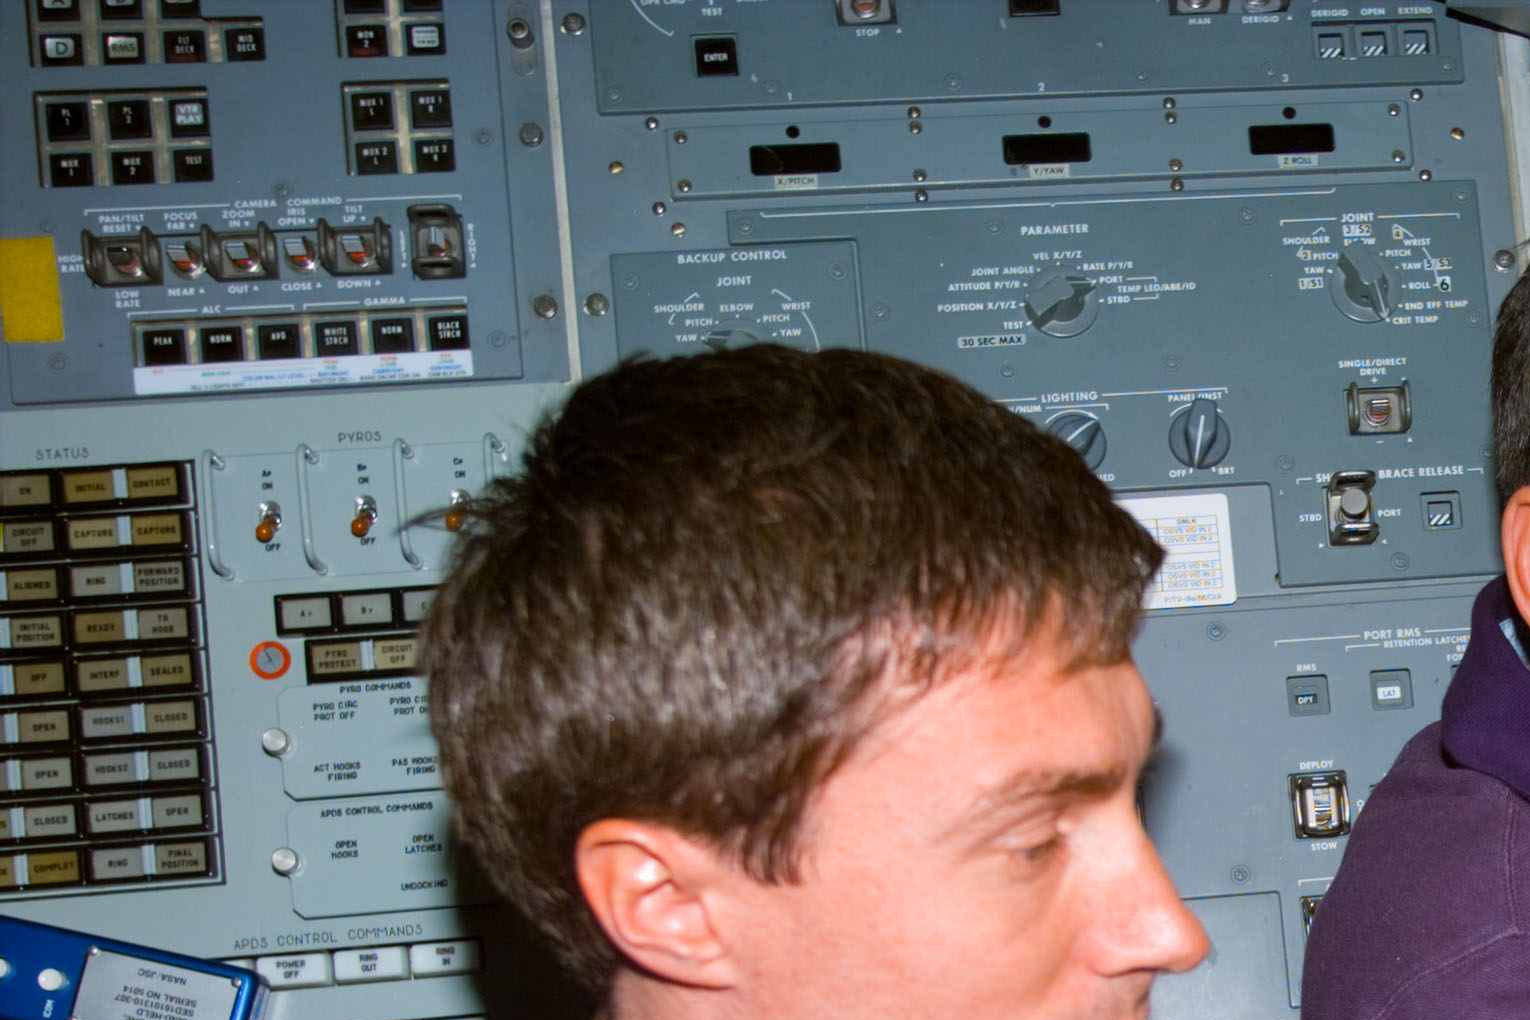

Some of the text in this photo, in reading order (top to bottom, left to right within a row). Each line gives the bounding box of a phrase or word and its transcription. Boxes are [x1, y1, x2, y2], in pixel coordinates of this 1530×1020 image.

[702, 8, 722, 16] TEST
[1311, 9, 1349, 17] DERIGID
[1361, 8, 1385, 16] OPEN
[1398, 6, 1433, 15] EXTEND
[856, 28, 879, 37] STOP
[55, 42, 68, 55] D
[704, 53, 728, 62] ENTER
[1282, 73, 1289, 83] 3
[1038, 82, 1045, 92] 2
[1033, 167, 1064, 176] Y/YAW
[776, 176, 815, 188] X/PITCH
[234, 197, 342, 209] CAMERA COMMAND
[287, 208, 306, 216] IRIS
[345, 205, 363, 214] TILT
[99, 213, 144, 223] PAN/TILT
[164, 211, 198, 221] FOCUS
[222, 210, 255, 219] ZOOM
[343, 214, 357, 223] UP
[1341, 213, 1375, 223] JOINT
[228, 219, 241, 228] IN
[278, 217, 306, 226] OPEN
[103, 223, 132, 232] RESET
[166, 222, 185, 231] FAR
[1020, 224, 1089, 236] PARAMETER
[1283, 236, 1330, 245] SHOULDER
[1403, 237, 1431, 246] WRIST
[677, 250, 787, 264] BACKUP CONTROL
[1033, 250, 1083, 261] VEL X/Y/Z
[1313, 252, 1339, 260] PITCH
[1385, 249, 1411, 257] PITCH
[1083, 263, 1104, 271] RATE
[1304, 266, 1324, 274] YAW
[1402, 262, 1422, 270] YAW
[971, 266, 1035, 277] JOINT ANGLE
[337, 279, 371, 289] DOWN
[716, 275, 752, 287] JOINT
[1099, 275, 1123, 284] PORT
[281, 282, 312, 291] CLOSE
[948, 282, 991, 292] ATTITUDE
[1409, 282, 1431, 290] ROLL
[1440, 278, 1449, 291] 6
[168, 288, 195, 297] NEAR
[228, 285, 248, 294] OUT
[1118, 285, 1141, 294] TEMP
[115, 290, 139, 300] LOW
[115, 299, 141, 309] RATE
[364, 297, 406, 306] GAMMA
[1107, 296, 1130, 304] STBD
[202, 305, 221, 314] ALC
[654, 303, 704, 313] SHOULDER
[720, 303, 754, 312] ELBOW
[781, 302, 811, 311] WRIST
[938, 300, 1017, 312] POSITION X/Y/Z
[1405, 300, 1468, 310] END EFF TEMP
[685, 318, 713, 327] PITCH
[763, 314, 791, 323] PITCH
[1415, 316, 1439, 324] TEMP
[1003, 321, 1024, 330] TEST
[779, 328, 802, 337] YAW
[675, 334, 697, 343] YAW
[961, 336, 1023, 347] 30 SEC MAX
[1338, 357, 1407, 369] SINGLE/DIRECT
[1360, 368, 1387, 376] DRIVE
[1041, 392, 1098, 403] LIGHTING
[337, 431, 382, 443] PYROS
[35, 447, 89, 460] STATUS
[1169, 470, 1187, 478] OFF
[1378, 466, 1464, 479] BRACE RELEASE
[1378, 509, 1401, 517] PORT
[1300, 514, 1322, 522] STBD
[12, 527, 44, 537] CIRCUIT
[74, 529, 113, 538] CAPTURE
[137, 525, 176, 535] CAPTURE
[86, 577, 106, 586] RING
[139, 577, 179, 587] POSITION
[1364, 628, 1421, 639] PORT RMS
[1384, 638, 1432, 648] RETENTION
[1296, 663, 1317, 672] RMS
[340, 681, 411, 694] PYRO COMMANDS
[1382, 689, 1396, 697] LAT
[313, 703, 335, 711] PYRO
[154, 712, 188, 723] CLOSED
[32, 723, 56, 732] OPEN
[157, 760, 191, 770] CLOSED
[314, 761, 361, 773] ACT HOOKS
[1300, 760, 1334, 770] DEPLOY
[35, 770, 59, 779] OPEN
[165, 807, 189, 816] OPEN
[346, 802, 433, 816] CONTROL COMMANDS
[33, 815, 68, 826] CLOSED
[95, 811, 134, 822] LATCHES
[413, 834, 434, 843] OPEN
[335, 840, 357, 849] OPEN
[1311, 842, 1337, 851] STOW
[108, 859, 129, 868] RING
[162, 859, 199, 869] POSITION
[234, 924, 423, 950] APDS CONTROL COMMANDS
[138, 967, 187, 986] NASA/JSC
[146, 989, 161, 999] NO
[164, 993, 197, 1008] SERIAL
